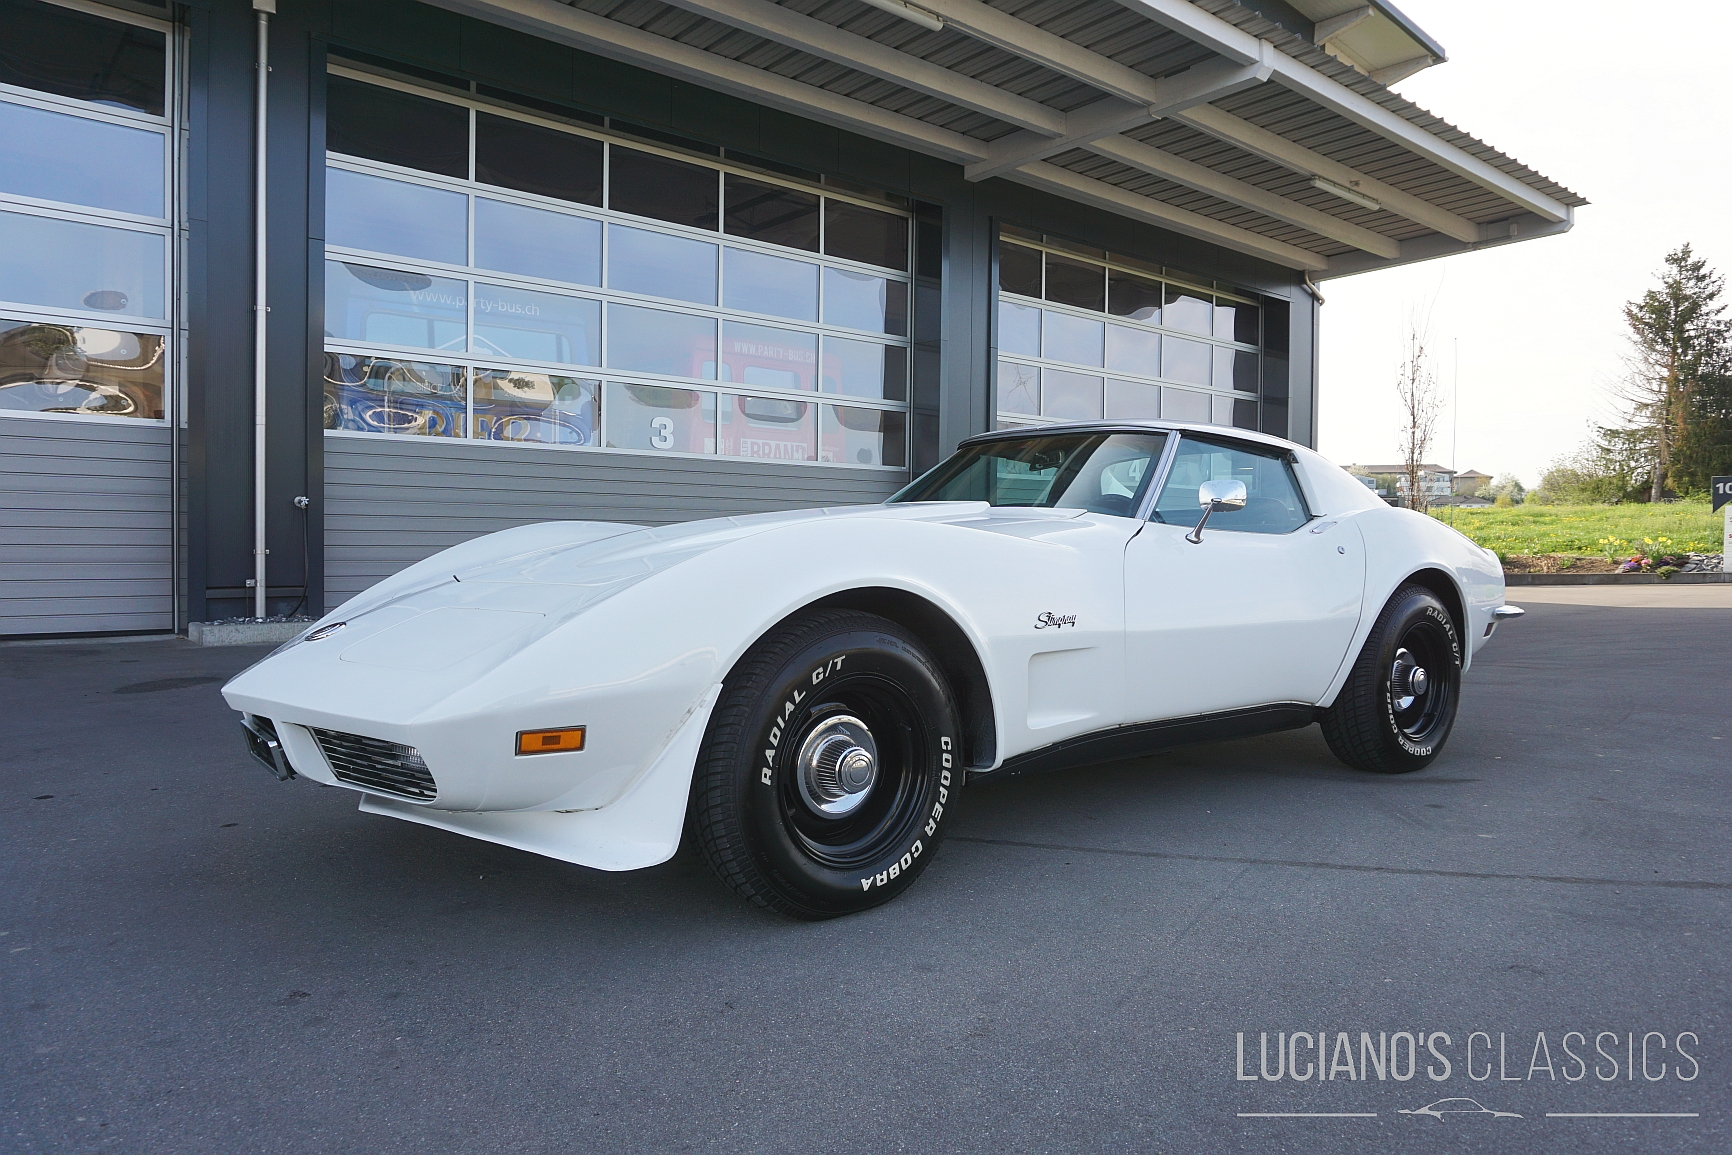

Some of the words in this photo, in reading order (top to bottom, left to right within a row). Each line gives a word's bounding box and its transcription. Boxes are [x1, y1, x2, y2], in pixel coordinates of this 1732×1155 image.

[650, 416, 675, 449] 3
[1128, 459, 1141, 481] 4
[1034, 611, 1077, 630] Stingray
[1426, 606, 1454, 640] RADIAL
[760, 689, 806, 786] RADIAL
[811, 654, 846, 686] G/T
[1397, 733, 1432, 756] COOPER
[924, 736, 953, 837] COOPER
[860, 839, 924, 892] COBRA
